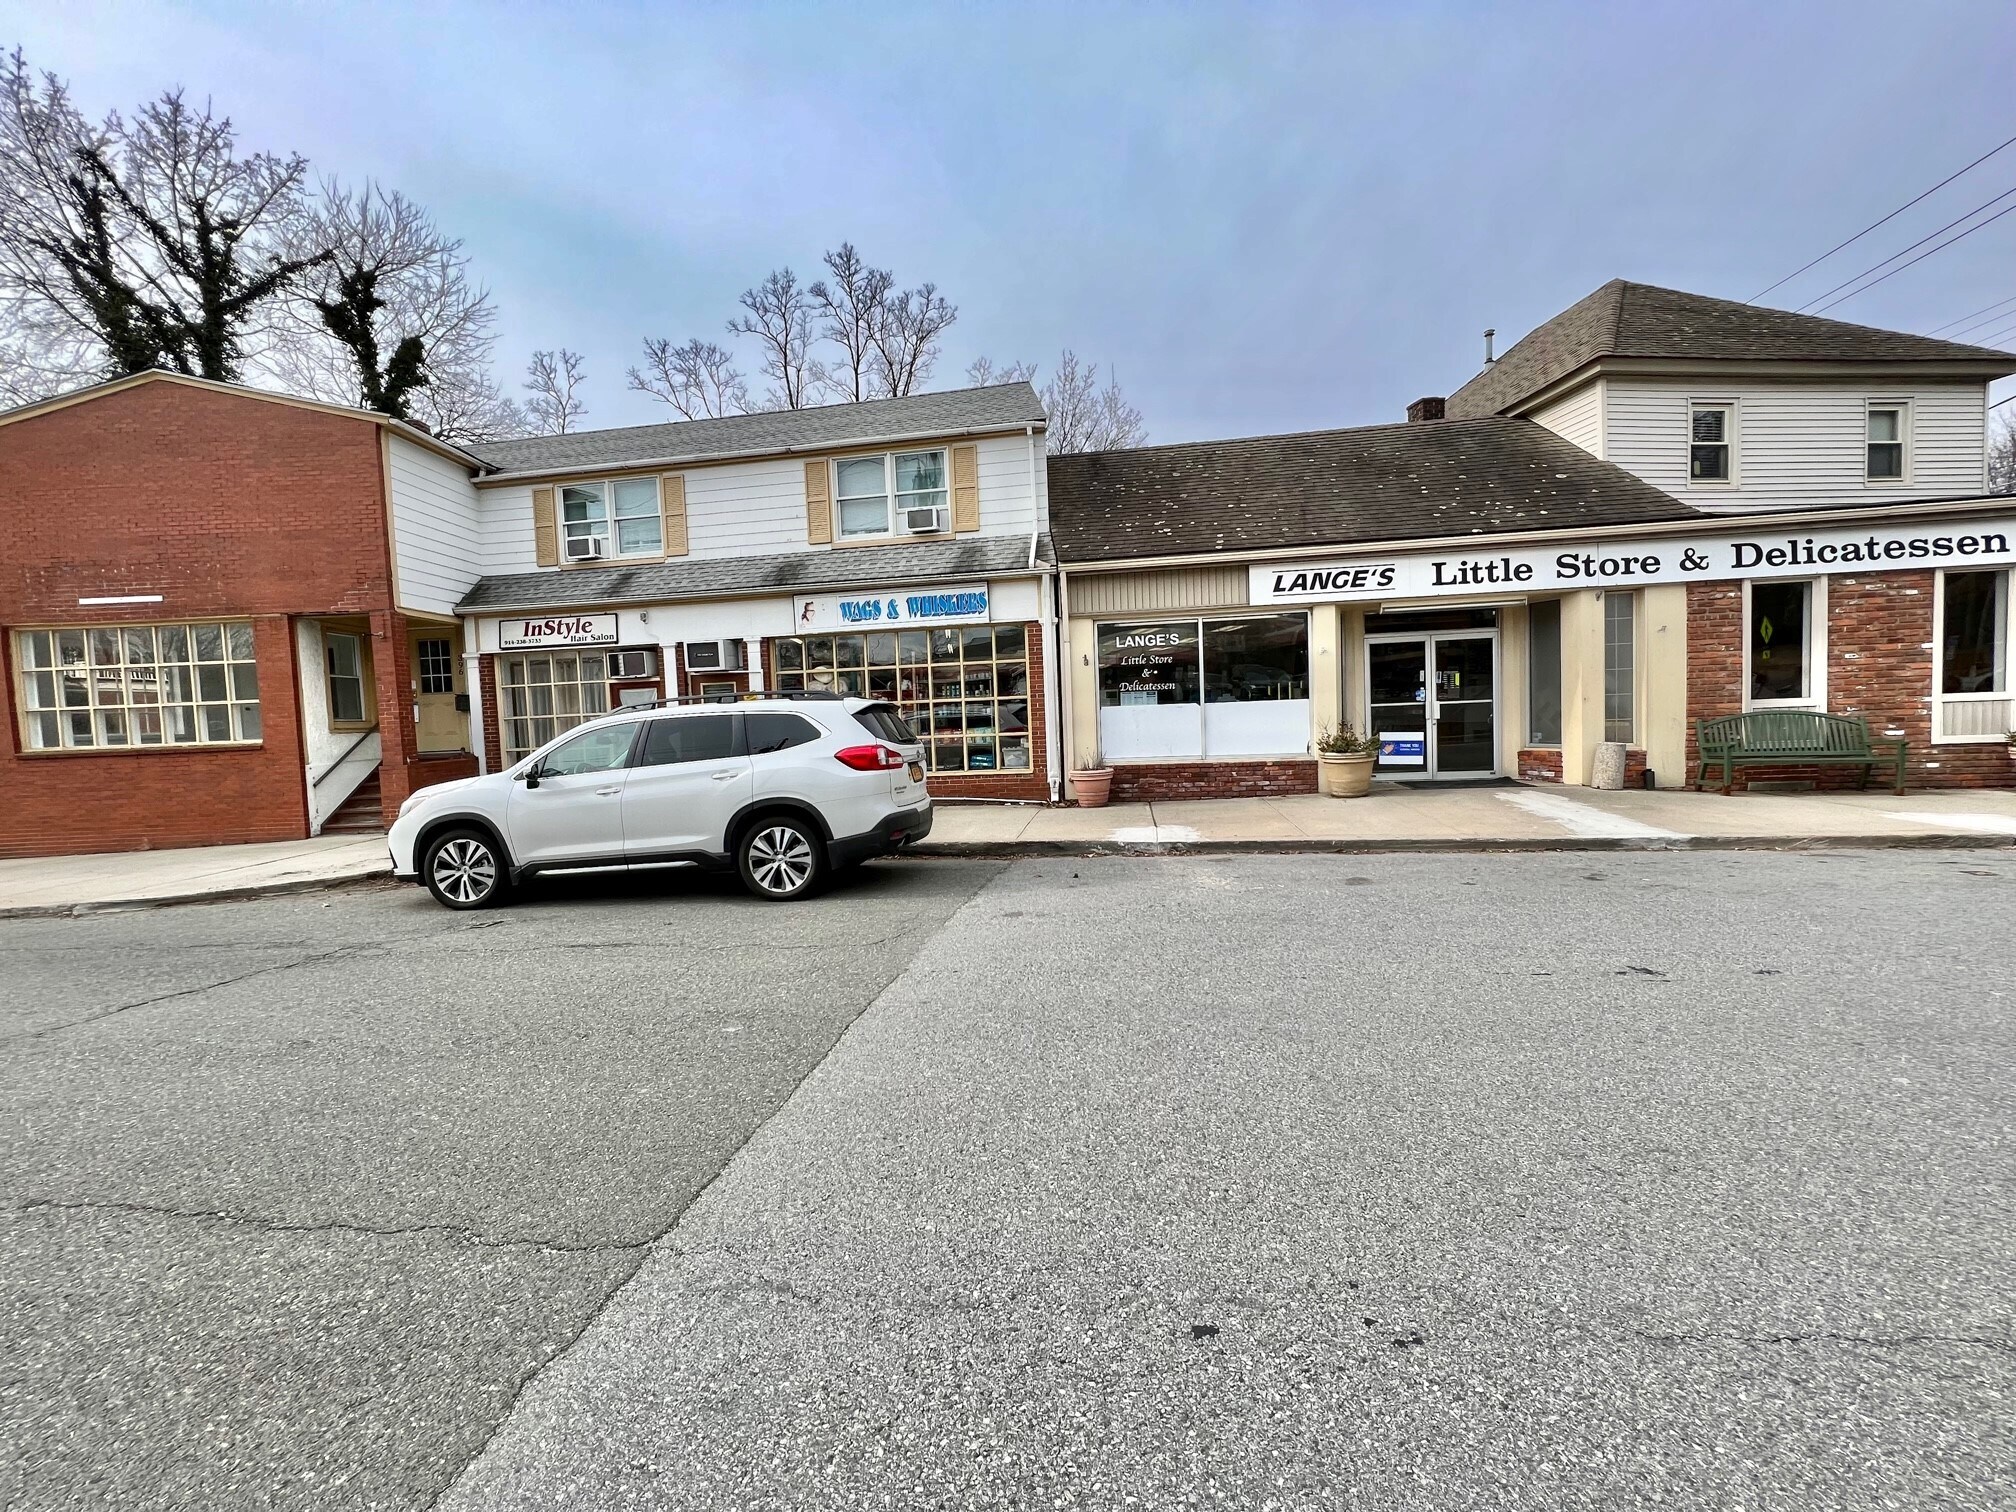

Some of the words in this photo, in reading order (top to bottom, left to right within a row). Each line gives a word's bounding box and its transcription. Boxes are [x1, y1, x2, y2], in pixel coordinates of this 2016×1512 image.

[1272, 567, 1395, 593] LANGE'S
[1431, 558, 1533, 586] Little
[1556, 551, 1661, 579] Store
[1679, 547, 1710, 572] &
[1731, 533, 2010, 569] Delicatessen
[839, 599, 882, 622] WAGS
[886, 599, 900, 620] &
[905, 591, 988, 618] WHISKERS
[523, 618, 593, 639] InStyle
[590, 633, 615, 641] Salon
[1116, 634, 1179, 648] LANGE'S
[1121, 653, 1147, 665] Little
[1149, 655, 1173, 664] Store
[1141, 668, 1152, 678] &
[1119, 680, 1176, 691] Delicatessen
